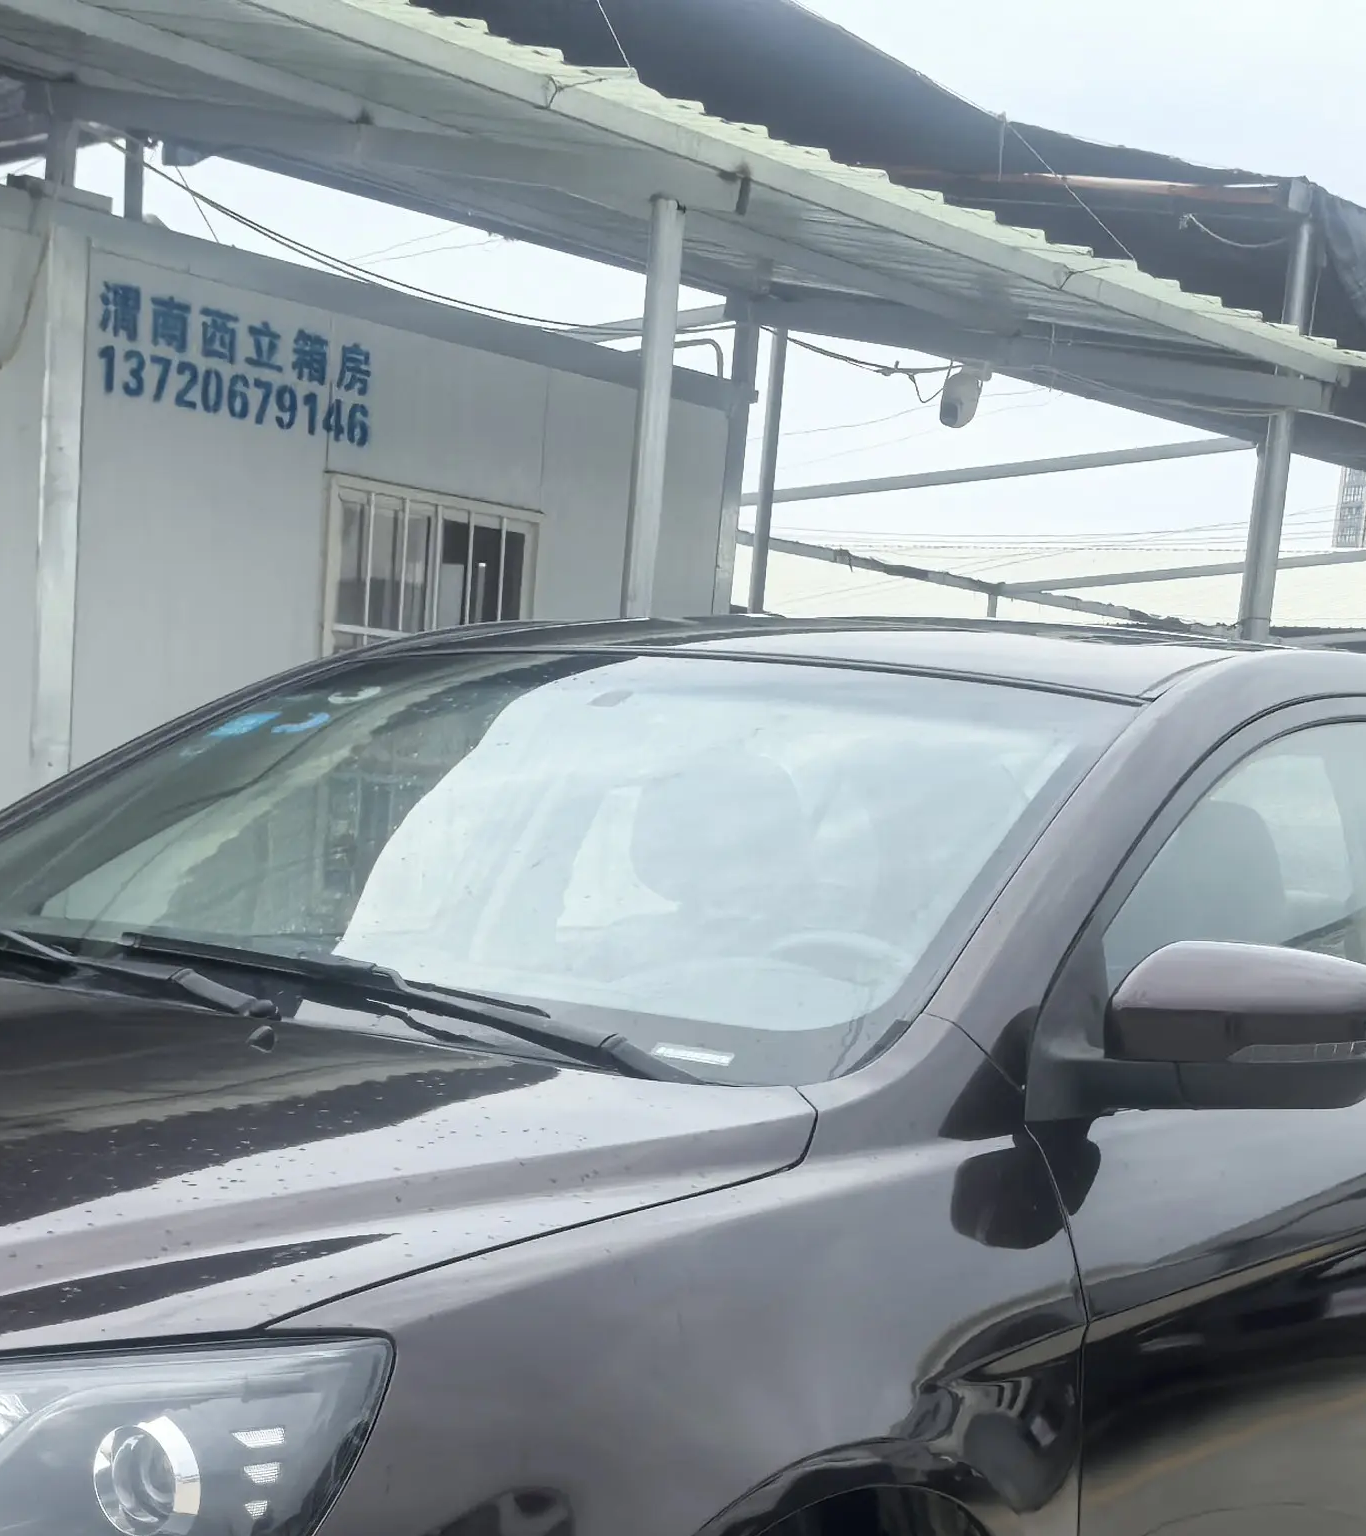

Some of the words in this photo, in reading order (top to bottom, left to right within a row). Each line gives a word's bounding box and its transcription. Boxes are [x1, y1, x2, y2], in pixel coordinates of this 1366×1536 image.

[99, 281, 372, 396] 渭南西立箱房
[98, 345, 370, 448] 13720679146
